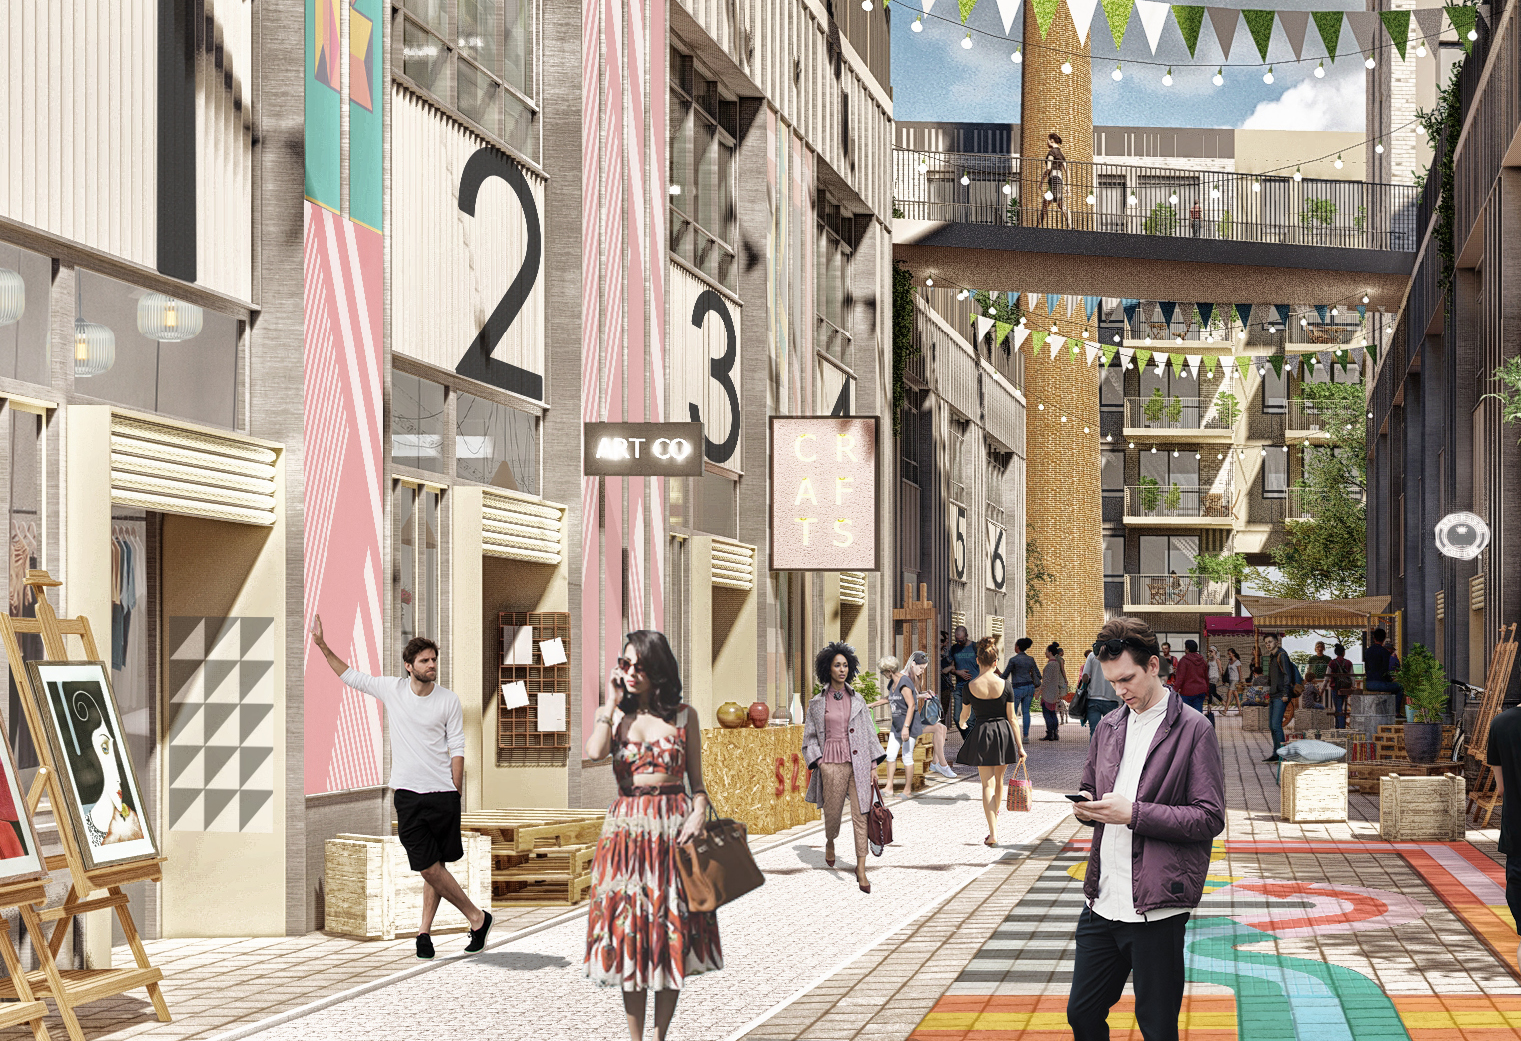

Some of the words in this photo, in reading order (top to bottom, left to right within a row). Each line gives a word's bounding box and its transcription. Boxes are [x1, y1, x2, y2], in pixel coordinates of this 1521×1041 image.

[455, 145, 543, 402] 2
[688, 289, 741, 463] 3
[595, 437, 646, 460] ART
[652, 437, 692, 461] CO
[954, 506, 966, 580] 5
[991, 528, 1006, 590] 6
